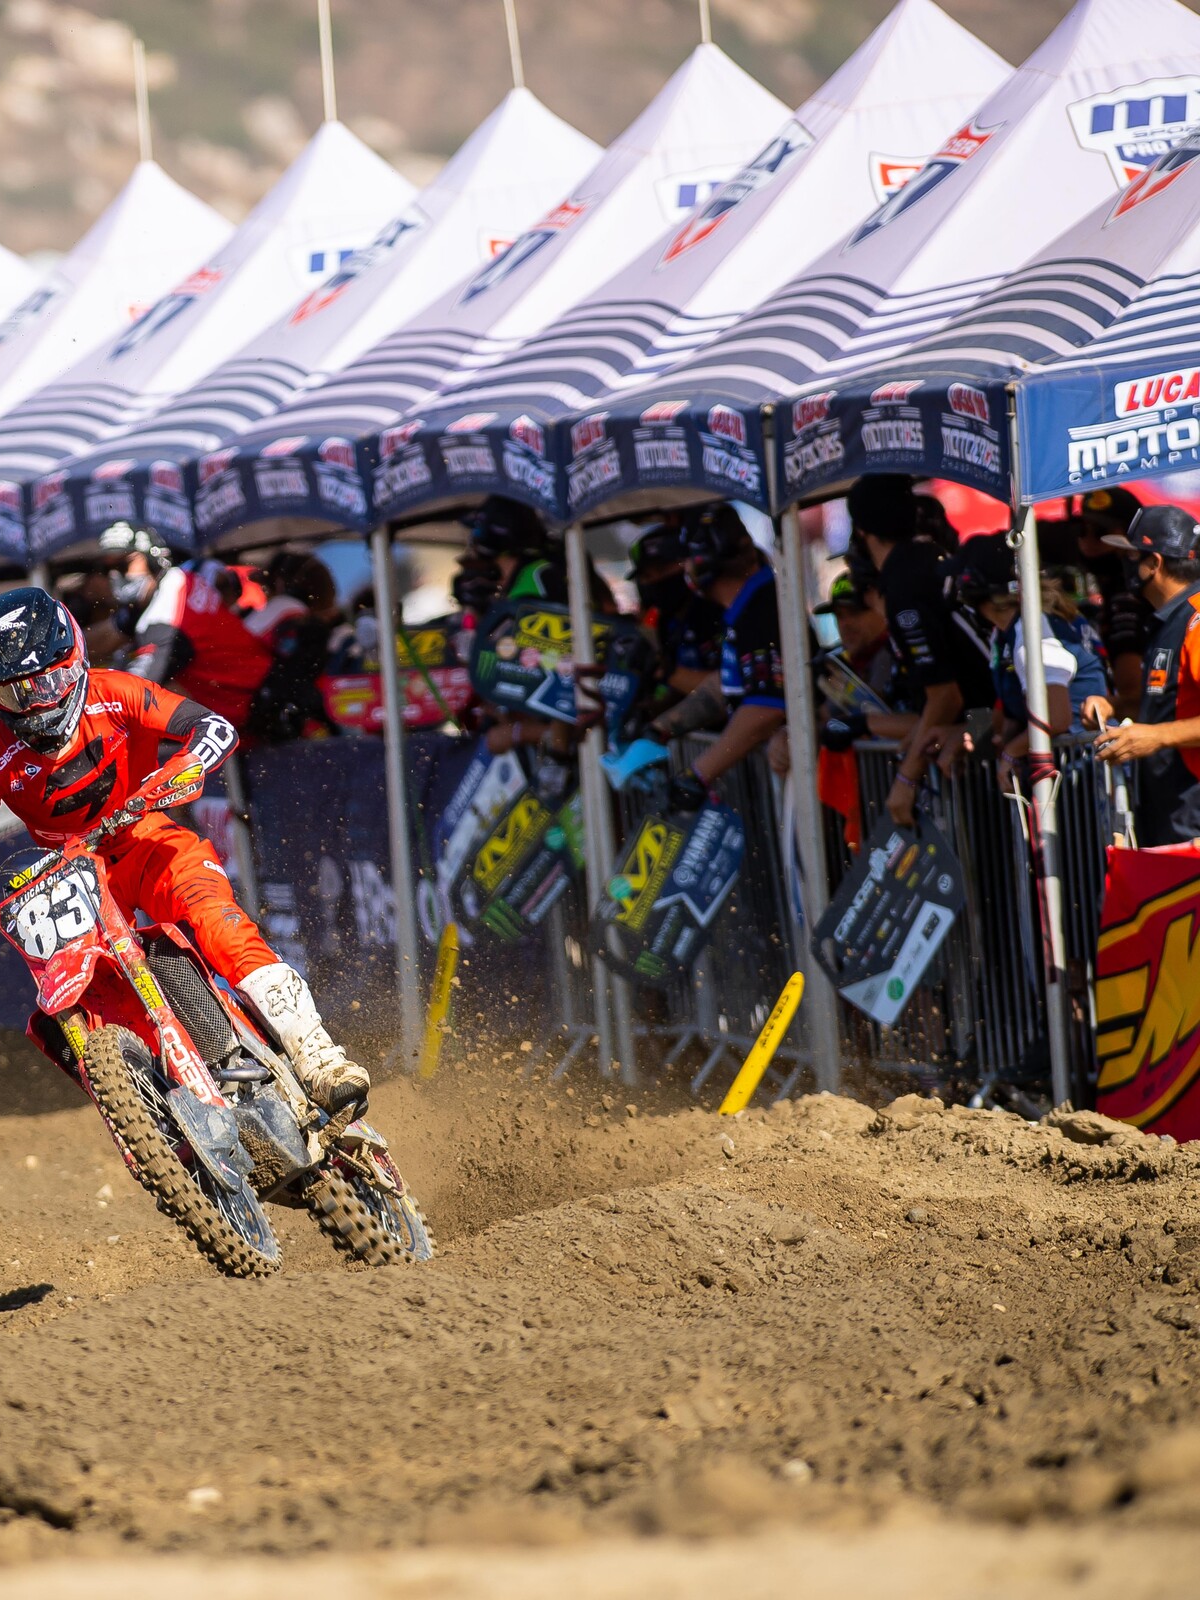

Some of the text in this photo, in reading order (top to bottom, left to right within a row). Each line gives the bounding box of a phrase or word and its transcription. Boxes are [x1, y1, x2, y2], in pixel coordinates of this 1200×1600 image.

[16, 870, 102, 960] 83
[19, 881, 47, 903] LUCAS
[46, 873, 63, 888] OIL
[163, 1026, 213, 1102] GEICO
